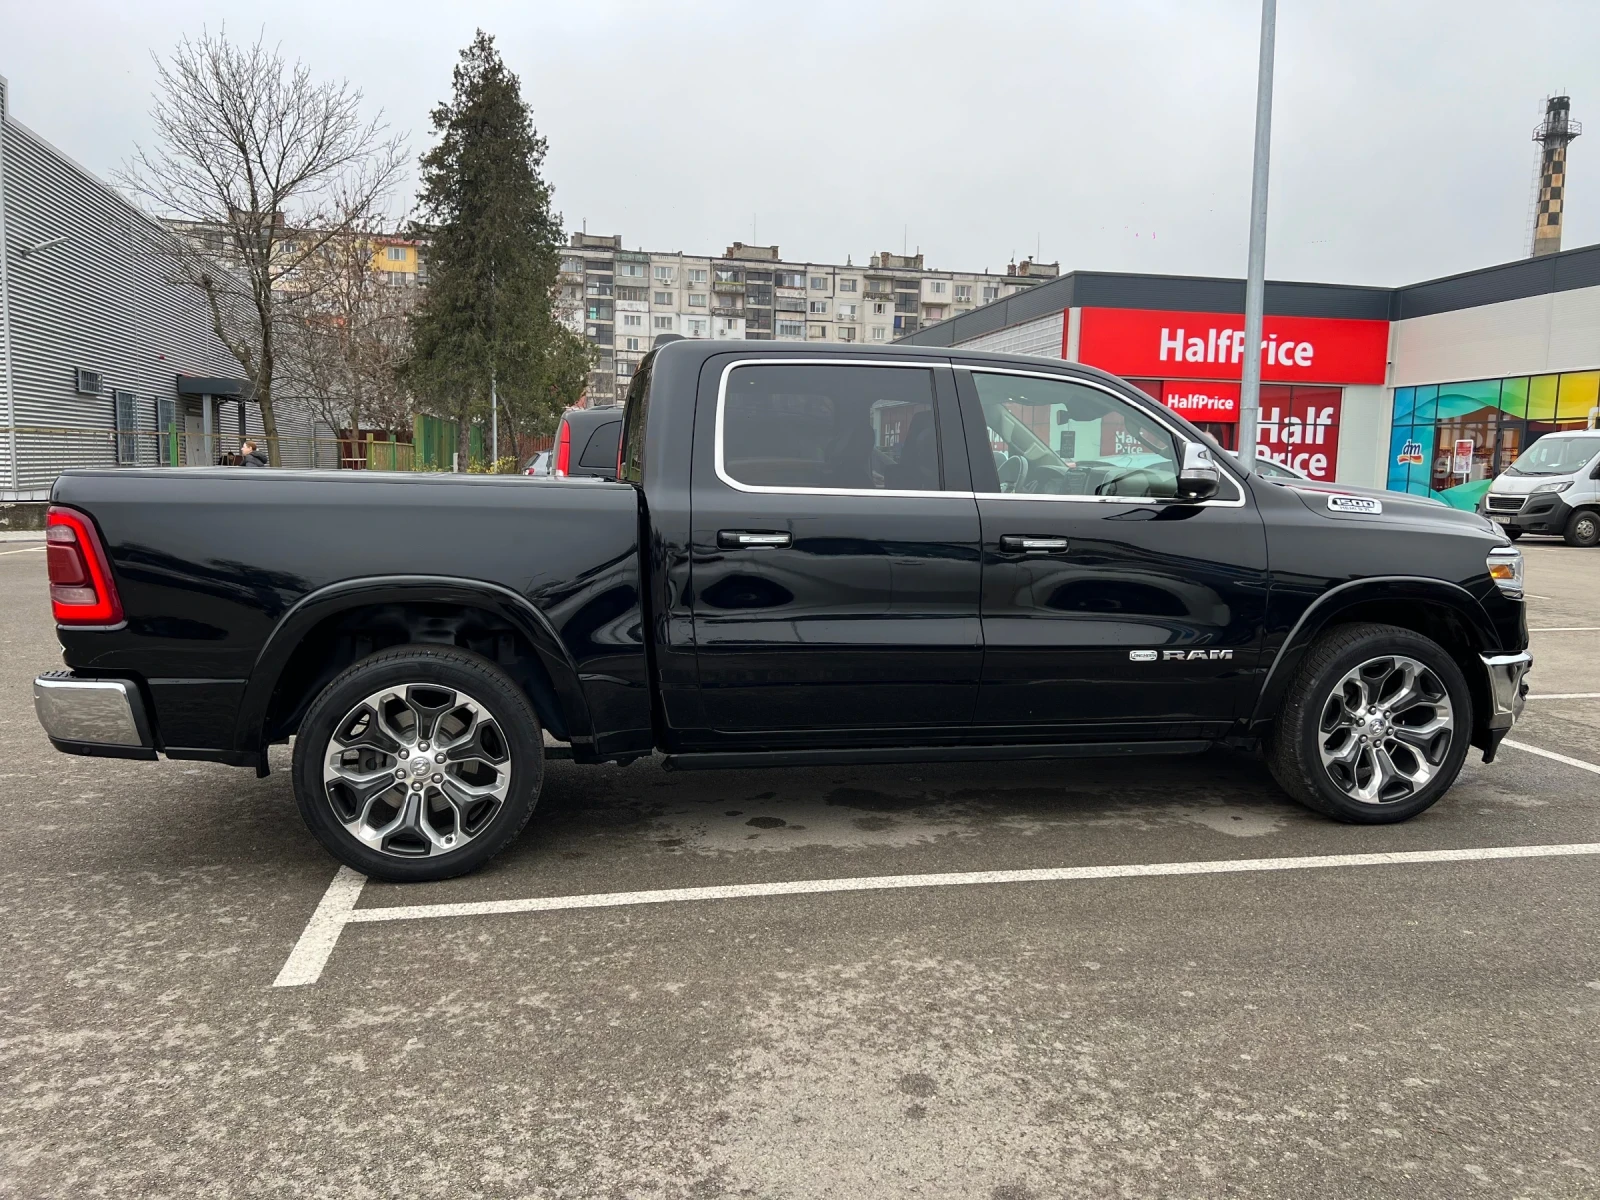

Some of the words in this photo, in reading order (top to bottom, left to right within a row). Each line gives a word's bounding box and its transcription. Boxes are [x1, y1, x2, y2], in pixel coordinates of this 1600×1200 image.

[1167, 394, 1234, 410] HalfPrice
[1256, 406, 1334, 445] Half
[1403, 440, 1421, 455] dm
[1332, 498, 1375, 508] 1500
[1162, 650, 1233, 660] RAM
